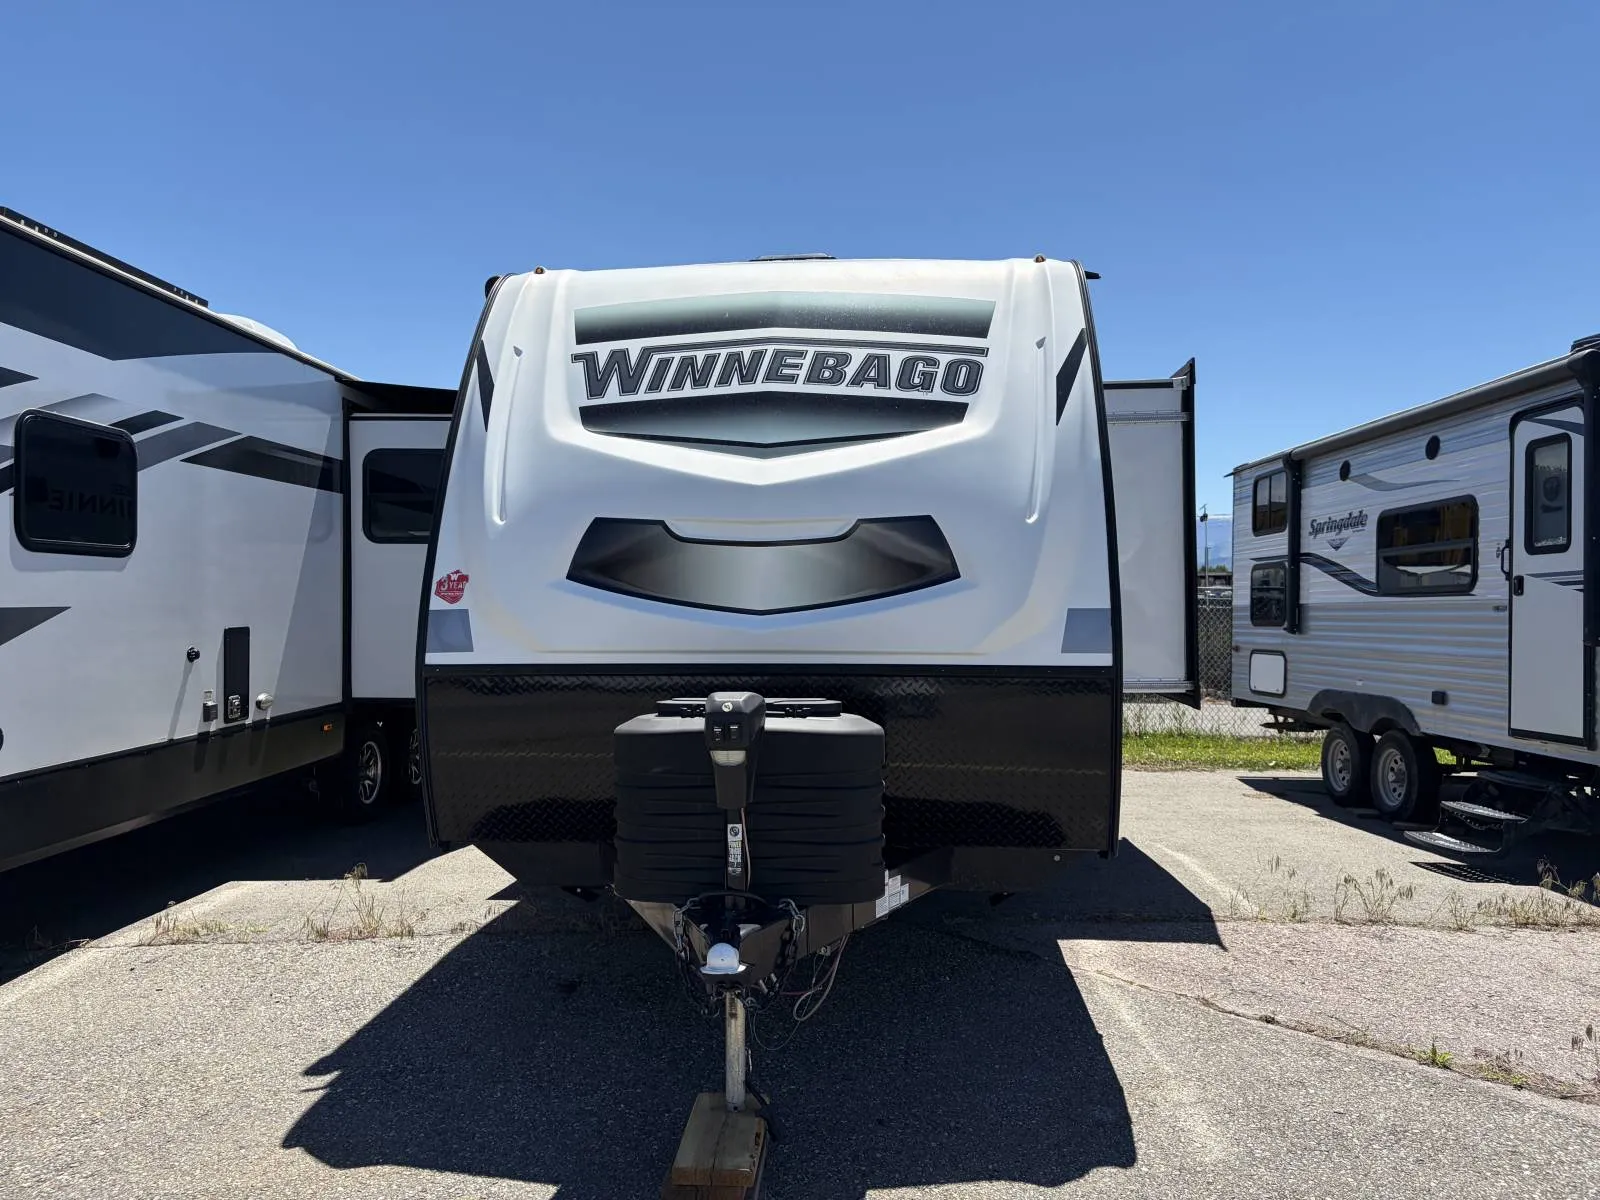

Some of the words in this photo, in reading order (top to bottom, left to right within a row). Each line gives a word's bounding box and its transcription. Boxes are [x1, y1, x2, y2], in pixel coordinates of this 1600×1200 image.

[571, 337, 989, 401] WINNEBAGO
[1308, 509, 1368, 539] Springdale
[440, 578, 449, 590] 3
